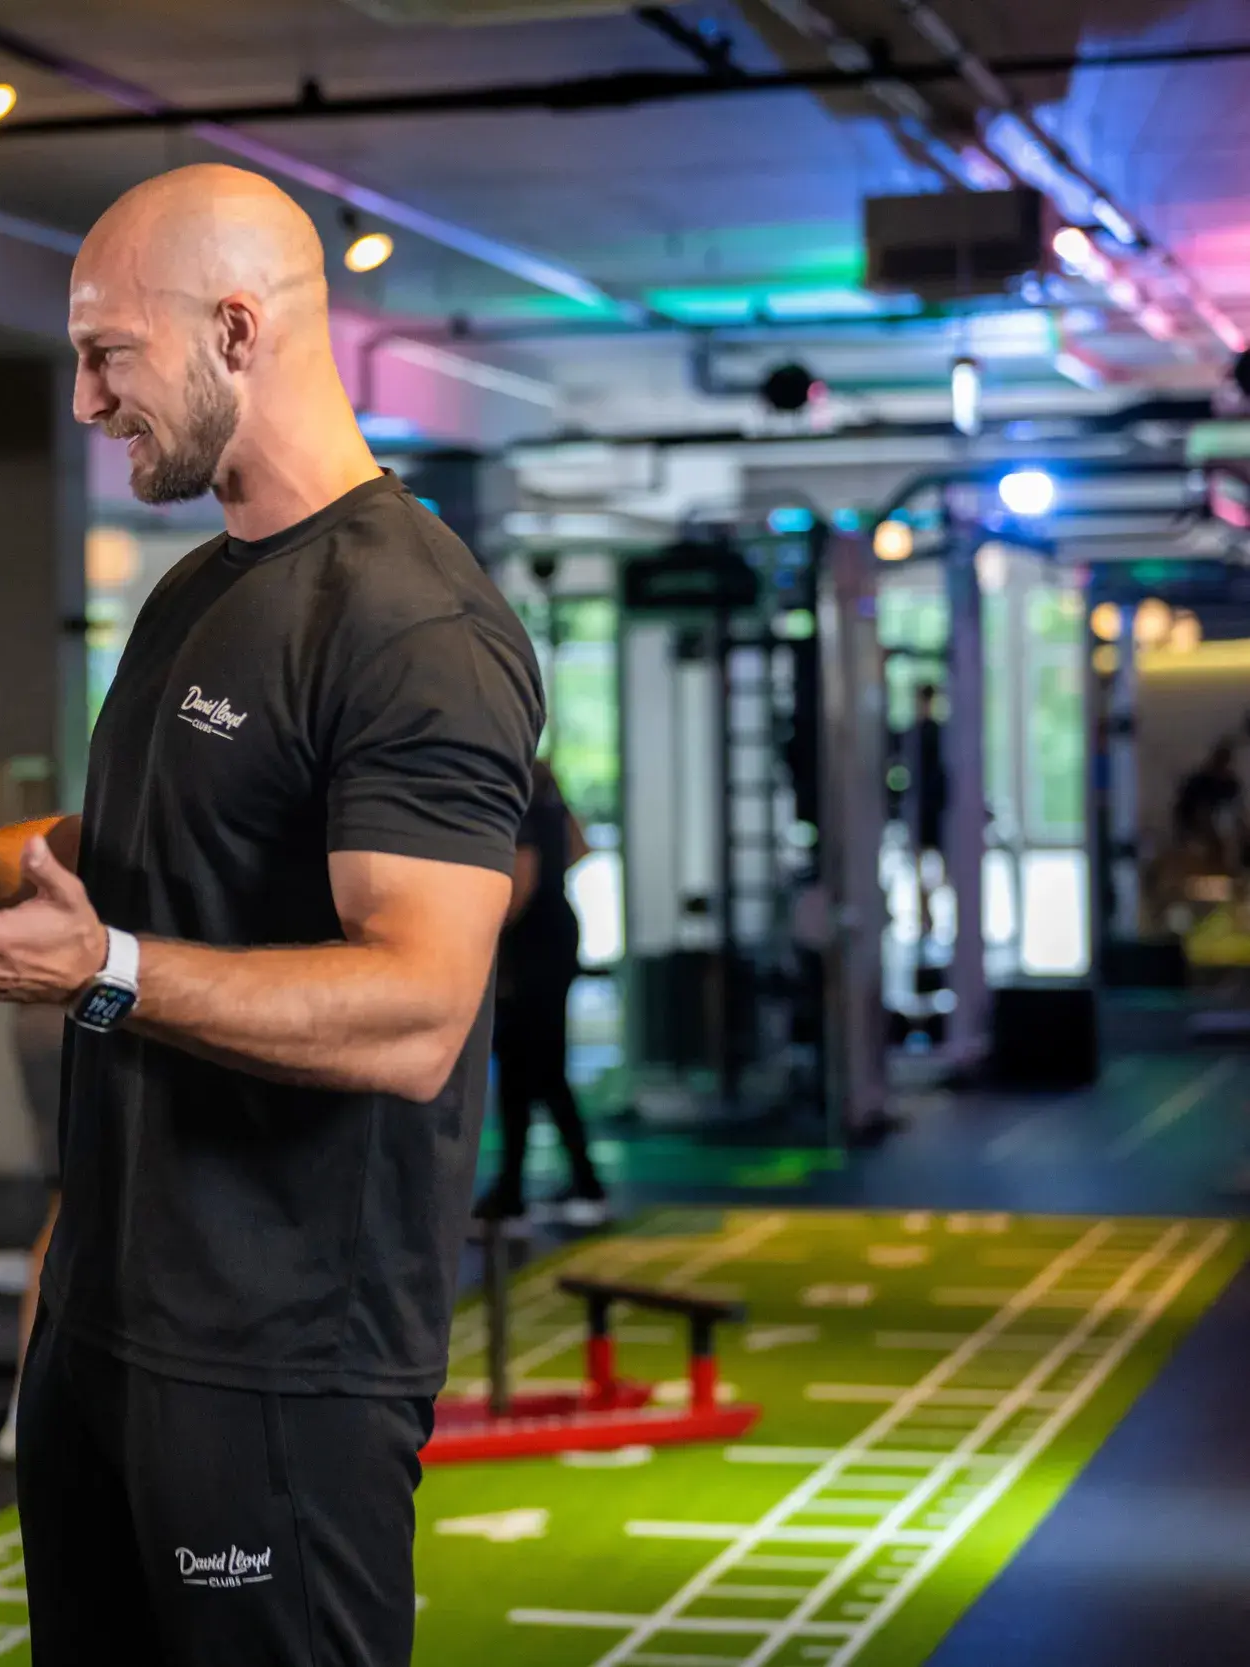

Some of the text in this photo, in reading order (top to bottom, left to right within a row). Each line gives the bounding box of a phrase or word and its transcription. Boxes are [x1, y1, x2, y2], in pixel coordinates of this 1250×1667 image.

[180, 685, 248, 730] David Lloyd
[191, 718, 214, 734] CLUBS
[175, 1543, 271, 1575] David Lloyd
[208, 1576, 242, 1588] CLUBS
